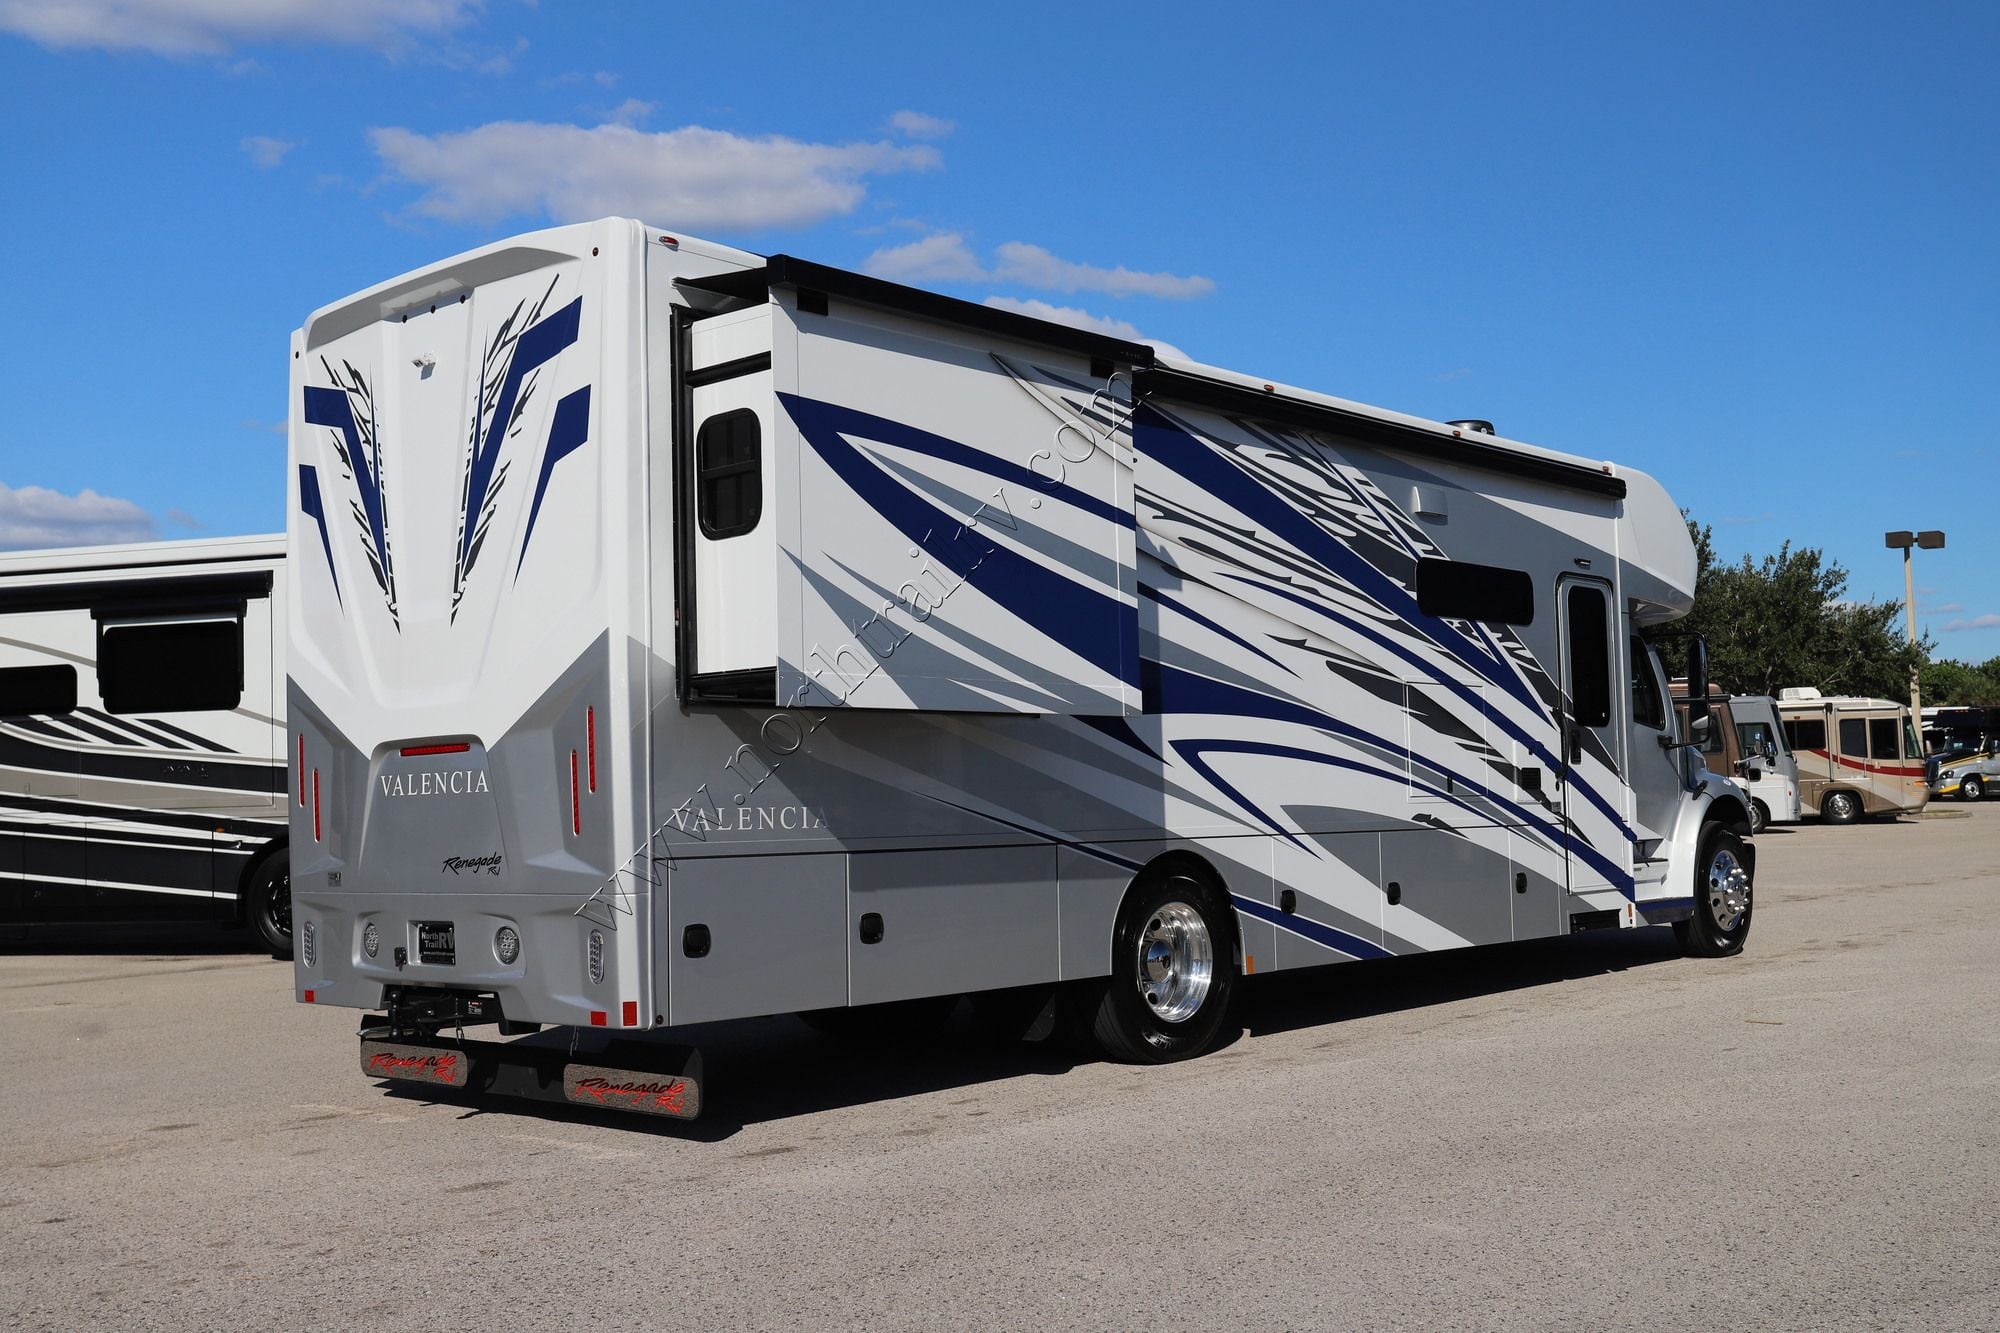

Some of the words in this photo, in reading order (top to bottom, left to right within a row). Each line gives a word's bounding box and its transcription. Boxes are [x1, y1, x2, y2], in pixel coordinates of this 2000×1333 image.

[381, 769, 489, 797] VALENCIA
[672, 806, 828, 832] VALENCIA
[442, 851, 502, 875] Renegade
[421, 931, 439, 940] North
[424, 940, 439, 948] Trail
[439, 931, 454, 949] RV
[369, 1051, 457, 1076] Renegade
[575, 1078, 686, 1104] Renegade
